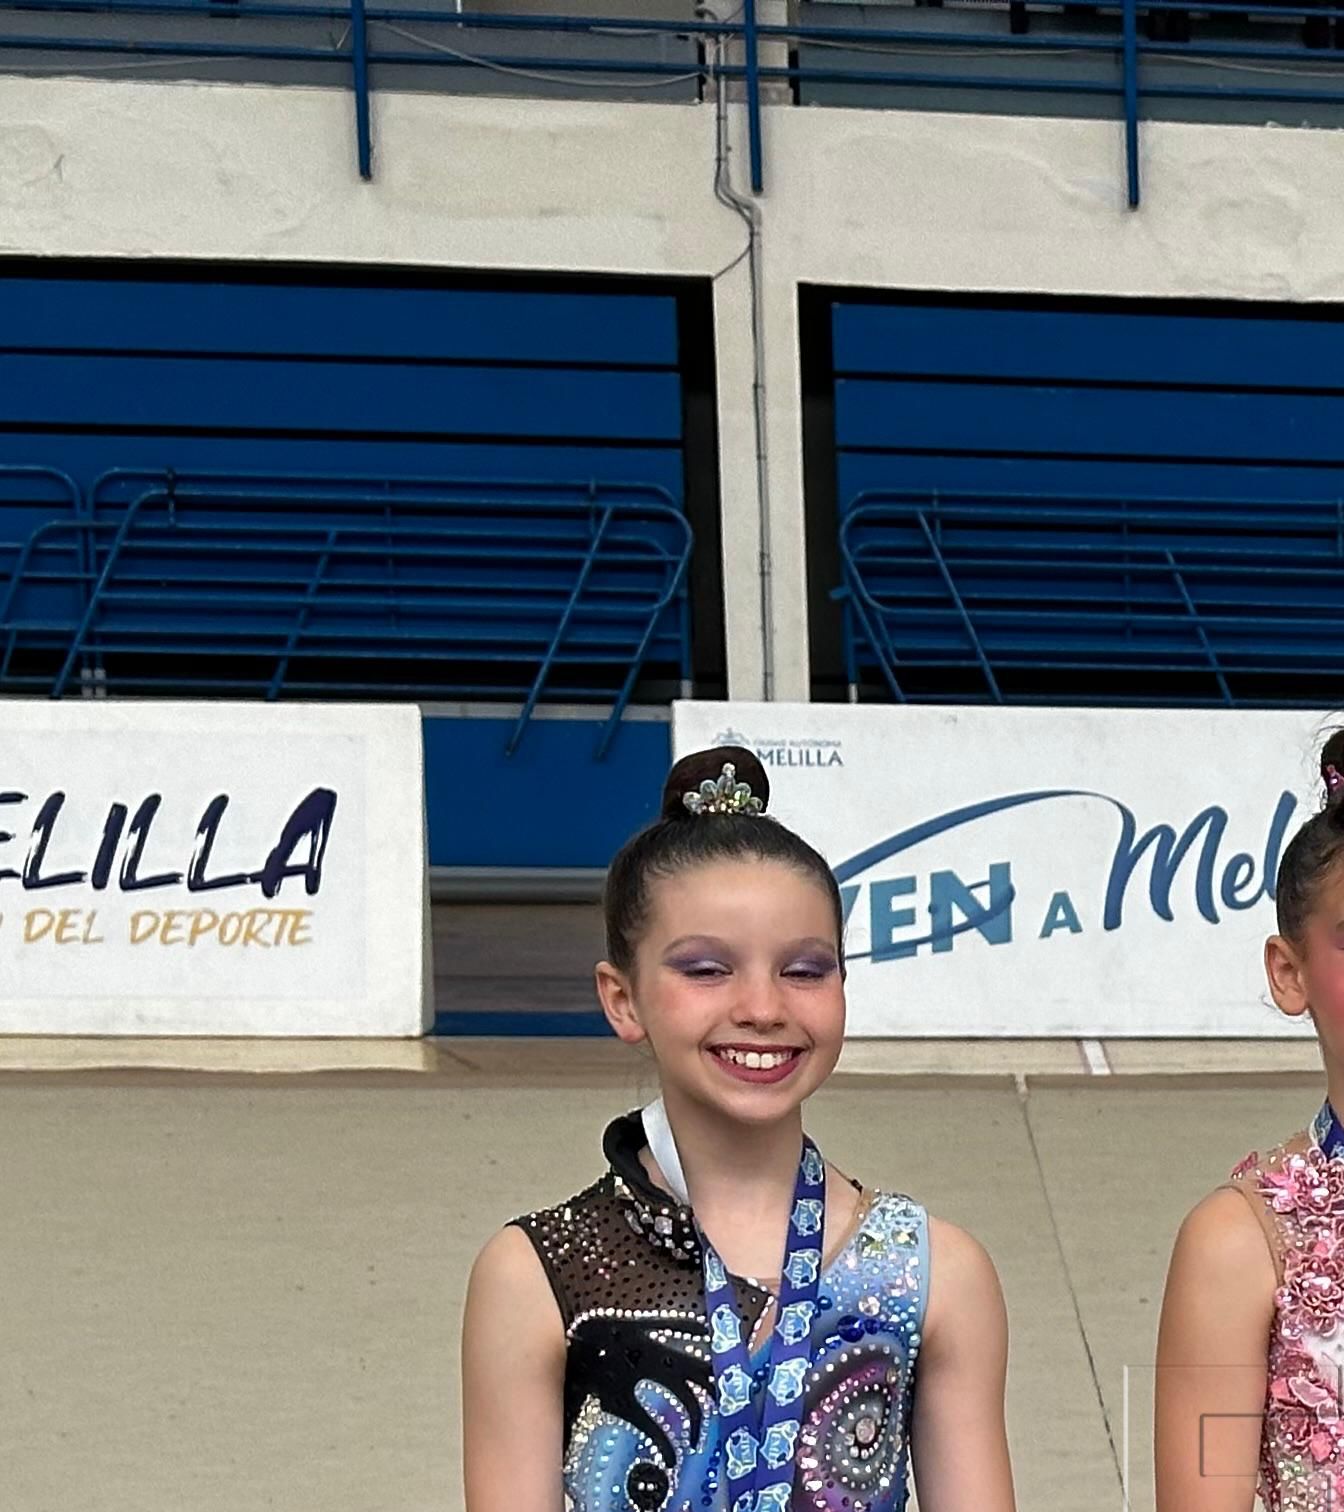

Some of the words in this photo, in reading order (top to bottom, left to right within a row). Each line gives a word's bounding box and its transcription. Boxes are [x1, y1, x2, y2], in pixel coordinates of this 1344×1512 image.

[757, 749, 844, 768] MELILLA
[23, 907, 105, 945] DEL
[130, 908, 315, 948] DEPORTE
